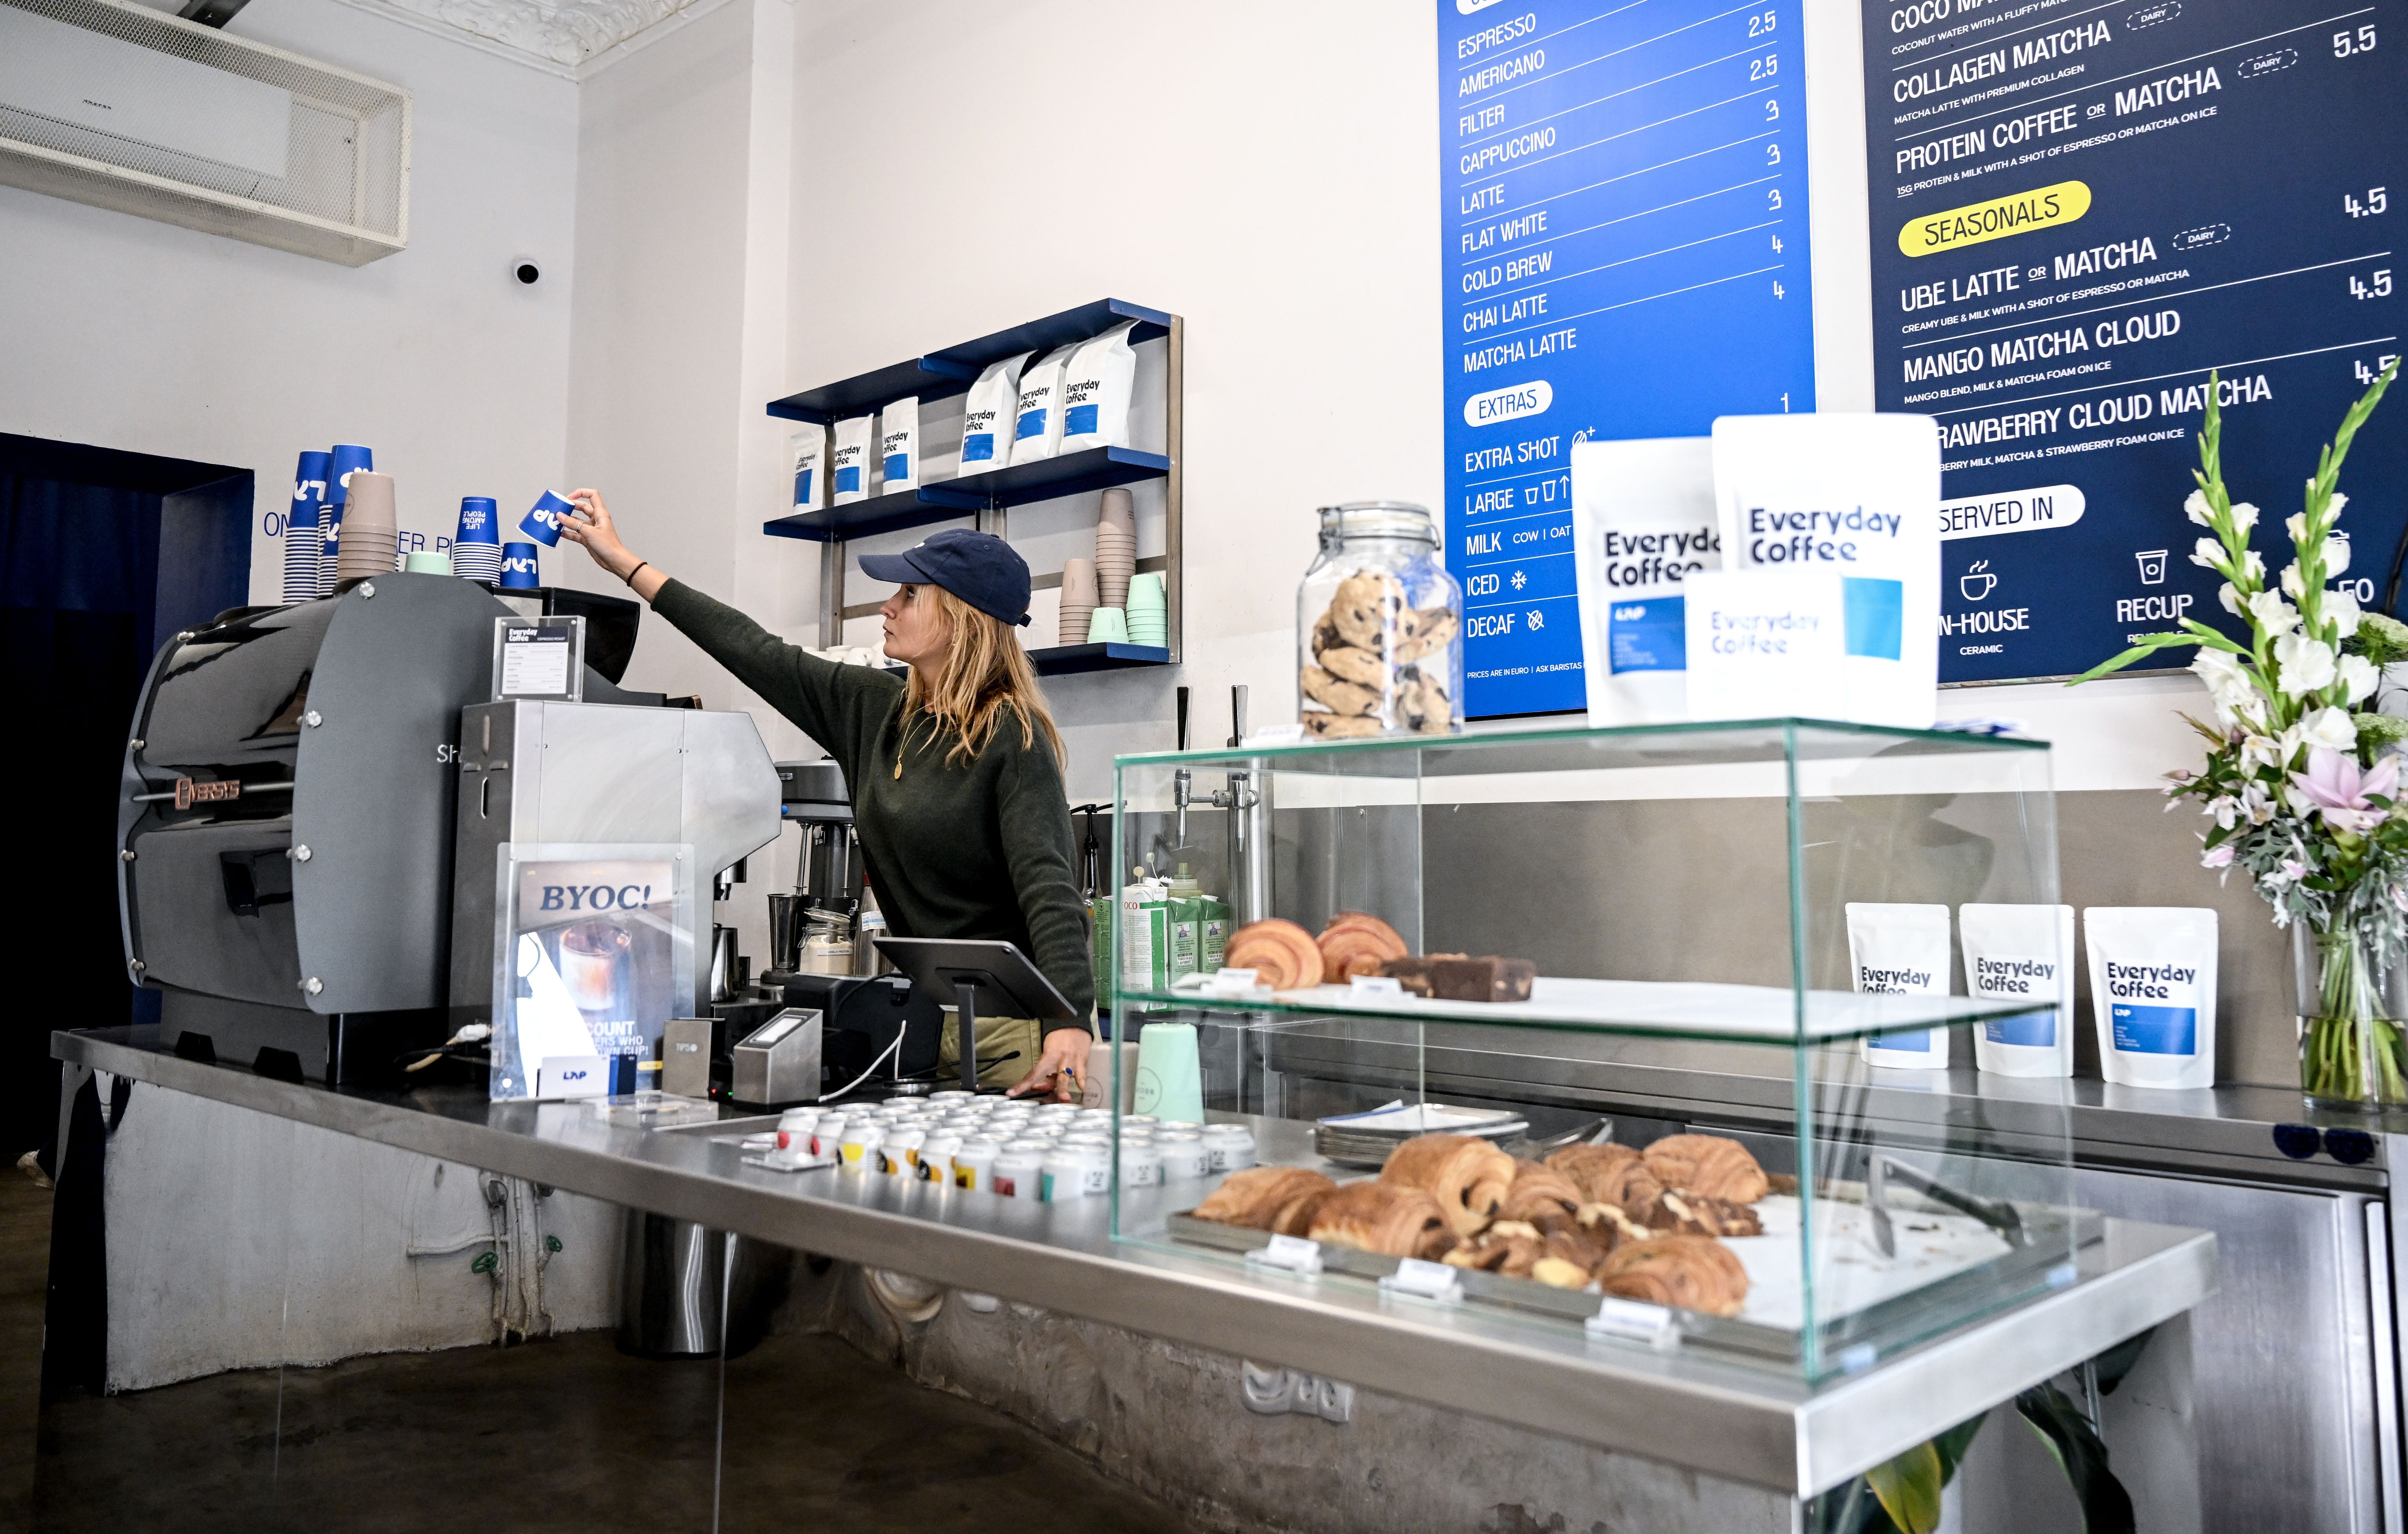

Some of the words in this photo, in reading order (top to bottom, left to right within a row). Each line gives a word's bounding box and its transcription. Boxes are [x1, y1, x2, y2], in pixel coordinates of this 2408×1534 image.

[1749, 10, 1775, 38] 2.5
[1891, 0, 1949, 33] COCO
[1892, 35, 1935, 54] COCONUT
[1938, 25, 1968, 40] WATER
[1971, 17, 1994, 30] WITH
[2005, 3, 2039, 20] FLUFFY
[1459, 13, 1535, 59] ESPRESSO
[2334, 25, 2375, 57] 5.5
[1751, 54, 1777, 81] 2.5
[1894, 50, 2005, 102] COLLAGEN
[2013, 20, 2111, 69] MATCHA
[2141, 9, 2166, 23] DAIRY
[1459, 50, 1544, 97] AMERICANO
[1895, 109, 1931, 124] MATCHA
[1933, 100, 1960, 114] LATTE
[1962, 93, 1985, 105] WITH
[1987, 80, 2029, 98] PREMIUM
[2031, 64, 2084, 85] COLLAGEN
[1460, 105, 1504, 136] FILTER
[1766, 100, 1779, 121] 3
[1897, 129, 1985, 176] PROTEIN
[1993, 104, 2077, 147] COFFEE
[2087, 103, 2105, 116] OR
[2115, 67, 2221, 118] MATCHA
[2254, 56, 2281, 71] DAIRY
[1461, 127, 1555, 174] CAPPUCCINO
[1767, 144, 1780, 165] 3
[1897, 185, 1912, 194] 15G
[1914, 175, 1951, 191] PROTEIN
[1962, 167, 1982, 178] MILK
[1984, 160, 2008, 172] WITH
[2019, 151, 2045, 163] SHOT
[2047, 147, 2061, 156] OF
[2063, 133, 2116, 152] ESPRESSO
[2118, 128, 2133, 138] OR
[2135, 117, 2179, 134] MATCHA
[2181, 111, 2198, 122] ON
[2199, 106, 2217, 118] ICE
[1462, 184, 1504, 214] LATTE
[1768, 189, 1781, 211] 3
[2345, 187, 2386, 218] 4.5
[1463, 226, 1496, 253] FLAT
[1500, 211, 1547, 241] WHITE
[1926, 194, 2059, 245] SEASONALS
[1772, 235, 1783, 253] 4
[1463, 266, 1501, 292] COLD
[1507, 251, 1552, 281] BREW
[1902, 281, 1945, 311] UBE
[1953, 266, 2019, 301] LATTE
[2028, 267, 2045, 278] OR
[2055, 237, 2157, 280] MATCHA
[2188, 231, 2214, 243] DAIRY
[2350, 269, 2392, 300] 4.5
[1774, 281, 1784, 300] 4
[1902, 320, 1939, 333] CREAMY
[1941, 316, 1958, 325] UBE
[1969, 309, 1990, 320] MILK
[1992, 304, 2016, 315] WITH
[2027, 296, 2054, 309] SHOT
[2056, 293, 2070, 302] OF
[2072, 282, 2125, 300] ESPRESSO
[2127, 279, 2143, 288] OR
[2145, 269, 2189, 285] MATCHA
[1464, 307, 1497, 332] CHAI
[1503, 293, 1547, 323] LATTE
[1465, 341, 1525, 373] MATCHA
[1530, 328, 1576, 358] LATTE
[1904, 347, 1983, 382] MANGO
[1991, 328, 2089, 367] MATCHA
[2096, 310, 2180, 347] CLOUD
[1067, 379, 1100, 394] Everyday
[1905, 391, 1938, 404] MANGO
[1940, 386, 1972, 398] BLEND,
[1973, 381, 1995, 392] MILK
[1996, 380, 2003, 388] &
[2005, 373, 2045, 387] MATCHA
[2047, 367, 2076, 379] FOAM
[2077, 364, 2093, 374] ON
[2095, 361, 2111, 371] ICE
[1066, 392, 1087, 404] Coffee
[1480, 389, 1536, 419] EXTRAS
[1781, 393, 1788, 412] 1
[966, 410, 996, 422] Everyday
[966, 422, 983, 432] Coffee
[1937, 407, 2061, 449] RAWBERRY
[2069, 394, 2152, 429] CLOUD
[798, 454, 816, 463] Everyday
[835, 445, 861, 457] veryday
[836, 457, 849, 465] offee
[884, 443, 897, 454] offee
[1466, 446, 1513, 472] EXTRA
[1518, 436, 1559, 462] SHOT
[1970, 457, 1993, 467] MILK,
[1995, 451, 2035, 463] MATCHA
[2046, 439, 2114, 456] STRAWBERRY
[2116, 434, 2147, 446] FOAM
[2149, 432, 2165, 441] ON
[2167, 428, 2184, 438] ICE
[796, 462, 808, 470] Coffee
[1467, 488, 1513, 515] LARGE
[1939, 501, 2022, 532] SERVED
[2033, 496, 2052, 521] IN
[1750, 505, 1901, 537] Everyday
[1467, 532, 1501, 555] MILK
[1513, 530, 1538, 543] COW
[1550, 525, 1571, 537] OAT
[1605, 528, 1721, 557] Everyd
[1752, 536, 1856, 563] Coffee
[1467, 574, 1499, 596] ICED
[1712, 611, 1819, 630] Everyday
[1938, 608, 2029, 636] N-HOUSE
[2117, 594, 2193, 623] RECUP
[1468, 614, 1515, 637] DECAF
[1712, 635, 1787, 654] Coffee
[1960, 644, 2003, 655] CERAMIC
[1550, 662, 1582, 671] BARISTAS
[540, 885, 650, 910] BYOC!
[1124, 902, 1138, 910] OCO
[1862, 966, 1931, 988] Everyday
[1978, 957, 2054, 980] Everyday
[2108, 962, 2196, 985] Everyday
[1978, 975, 2029, 993] Coffee
[2110, 980, 2168, 999] Coffee
[618, 1035, 643, 1046] WHO
